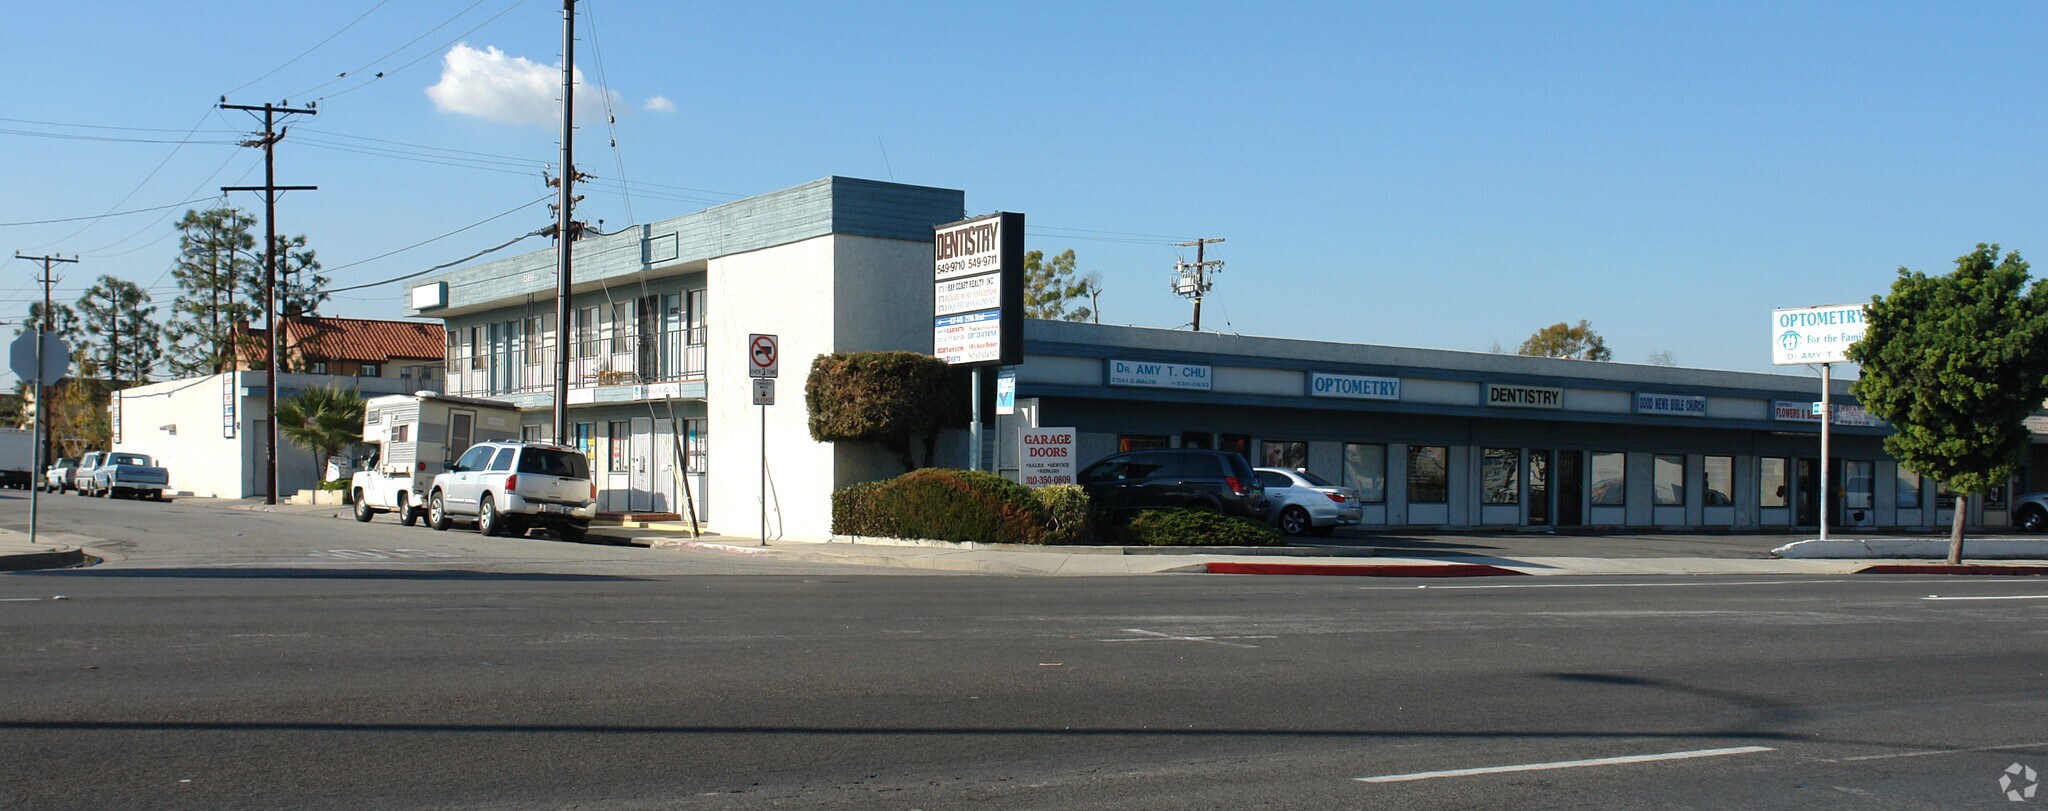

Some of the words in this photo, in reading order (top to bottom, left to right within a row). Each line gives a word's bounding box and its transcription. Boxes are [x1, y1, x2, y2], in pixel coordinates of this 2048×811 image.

[937, 221, 999, 261] DENTISTRY
[937, 260, 965, 275] 549-9710
[968, 254, 997, 269] 549-9711
[1780, 309, 1864, 328] OPTOMETRY
[1807, 334, 1820, 344] For
[1824, 333, 1838, 343] the
[1841, 332, 1865, 342] Famil
[1801, 352, 1822, 360] AMY
[761, 368, 766, 376] 3
[1136, 364, 1161, 376] AMY
[1167, 366, 1178, 377] T.
[1182, 367, 1206, 378] CHU
[1315, 376, 1398, 396] OPTOMETRY
[1491, 387, 1559, 405] DENTISTRY
[1640, 396, 1653, 410] GOOD
[1655, 397, 1668, 411] NEWS
[1670, 398, 1684, 411] BIBLE
[1685, 399, 1705, 412] CHURCH
[1776, 407, 1800, 419] FLOWERS
[1024, 434, 1072, 445] GARAGE
[1030, 447, 1068, 457] DOORS
[1026, 475, 1071, 485] 310-350-0809
